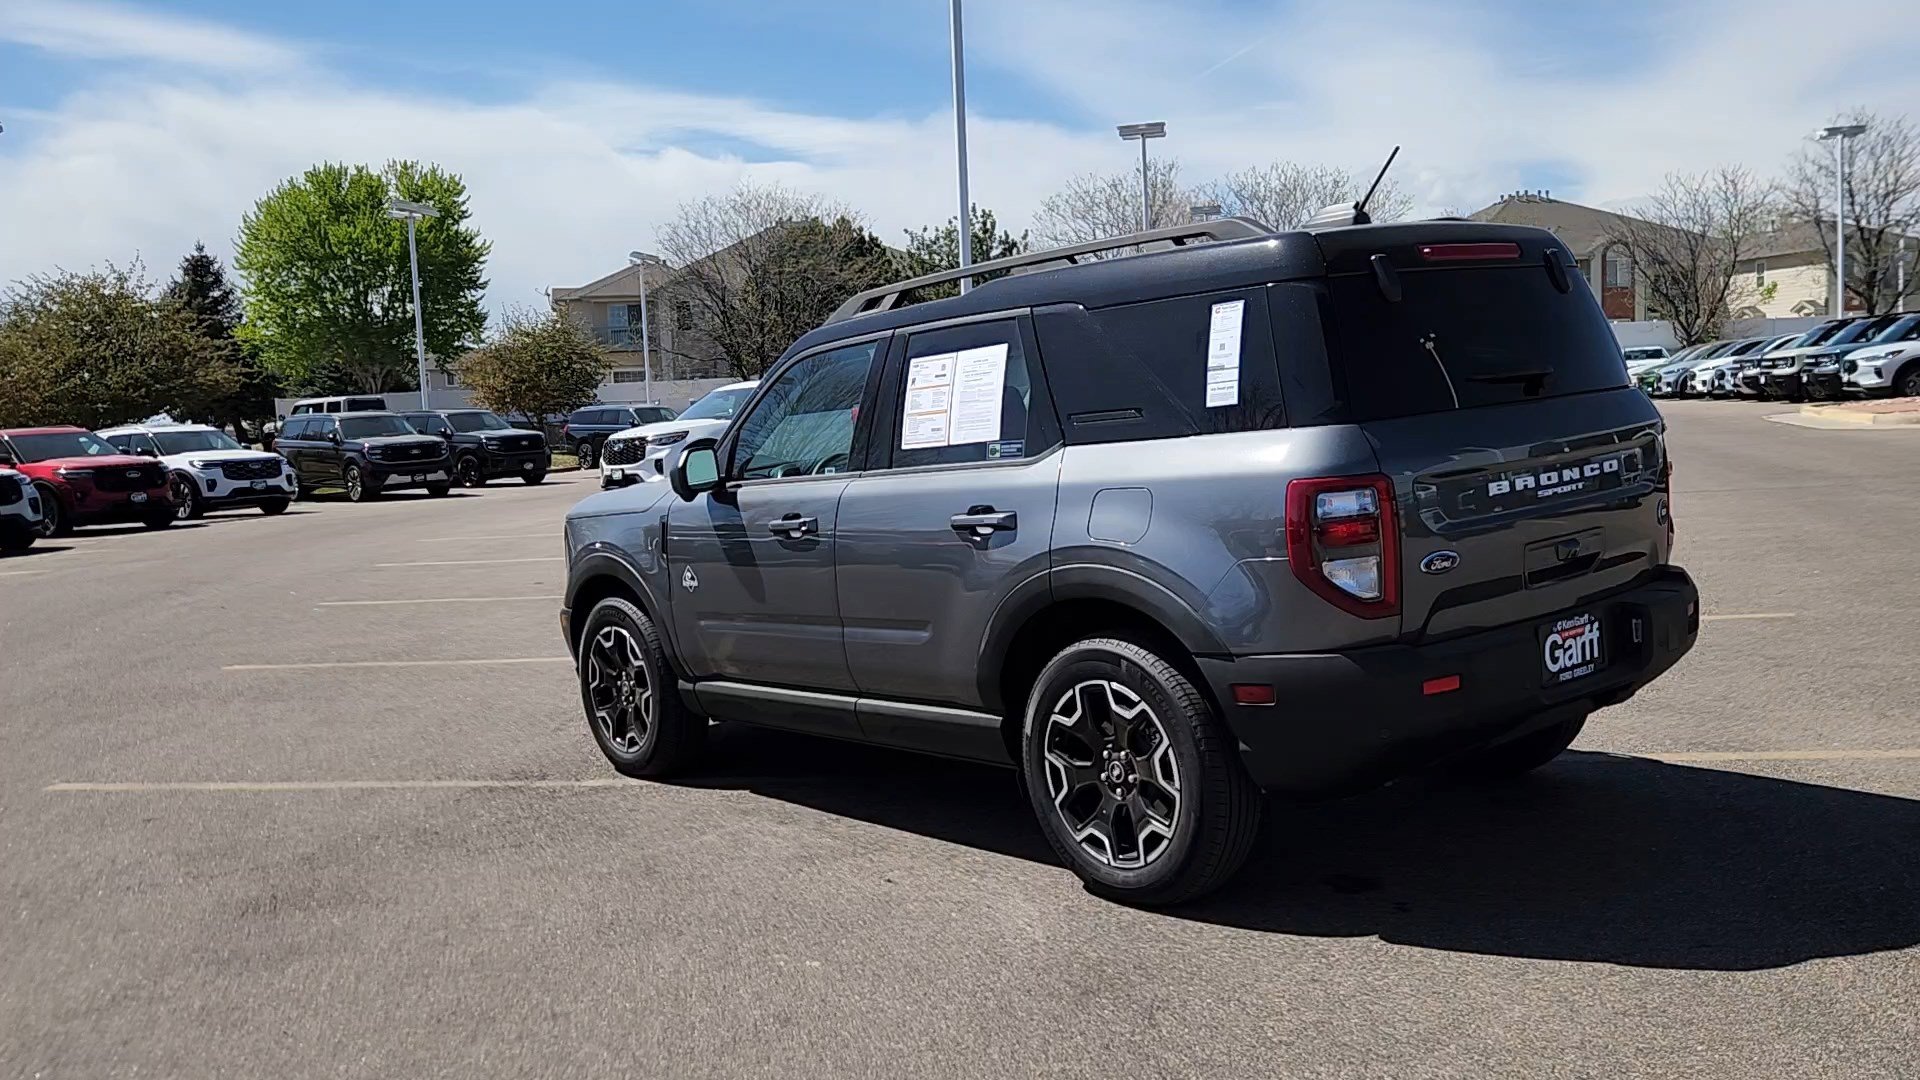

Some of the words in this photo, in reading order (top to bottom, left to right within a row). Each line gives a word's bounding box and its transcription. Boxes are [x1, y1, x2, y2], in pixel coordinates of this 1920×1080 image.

[1488, 459, 1619, 497] BRONCO
[1537, 482, 1585, 498] SPORT
[1430, 556, 1453, 570] Ford
[1544, 621, 1600, 673] Garff
